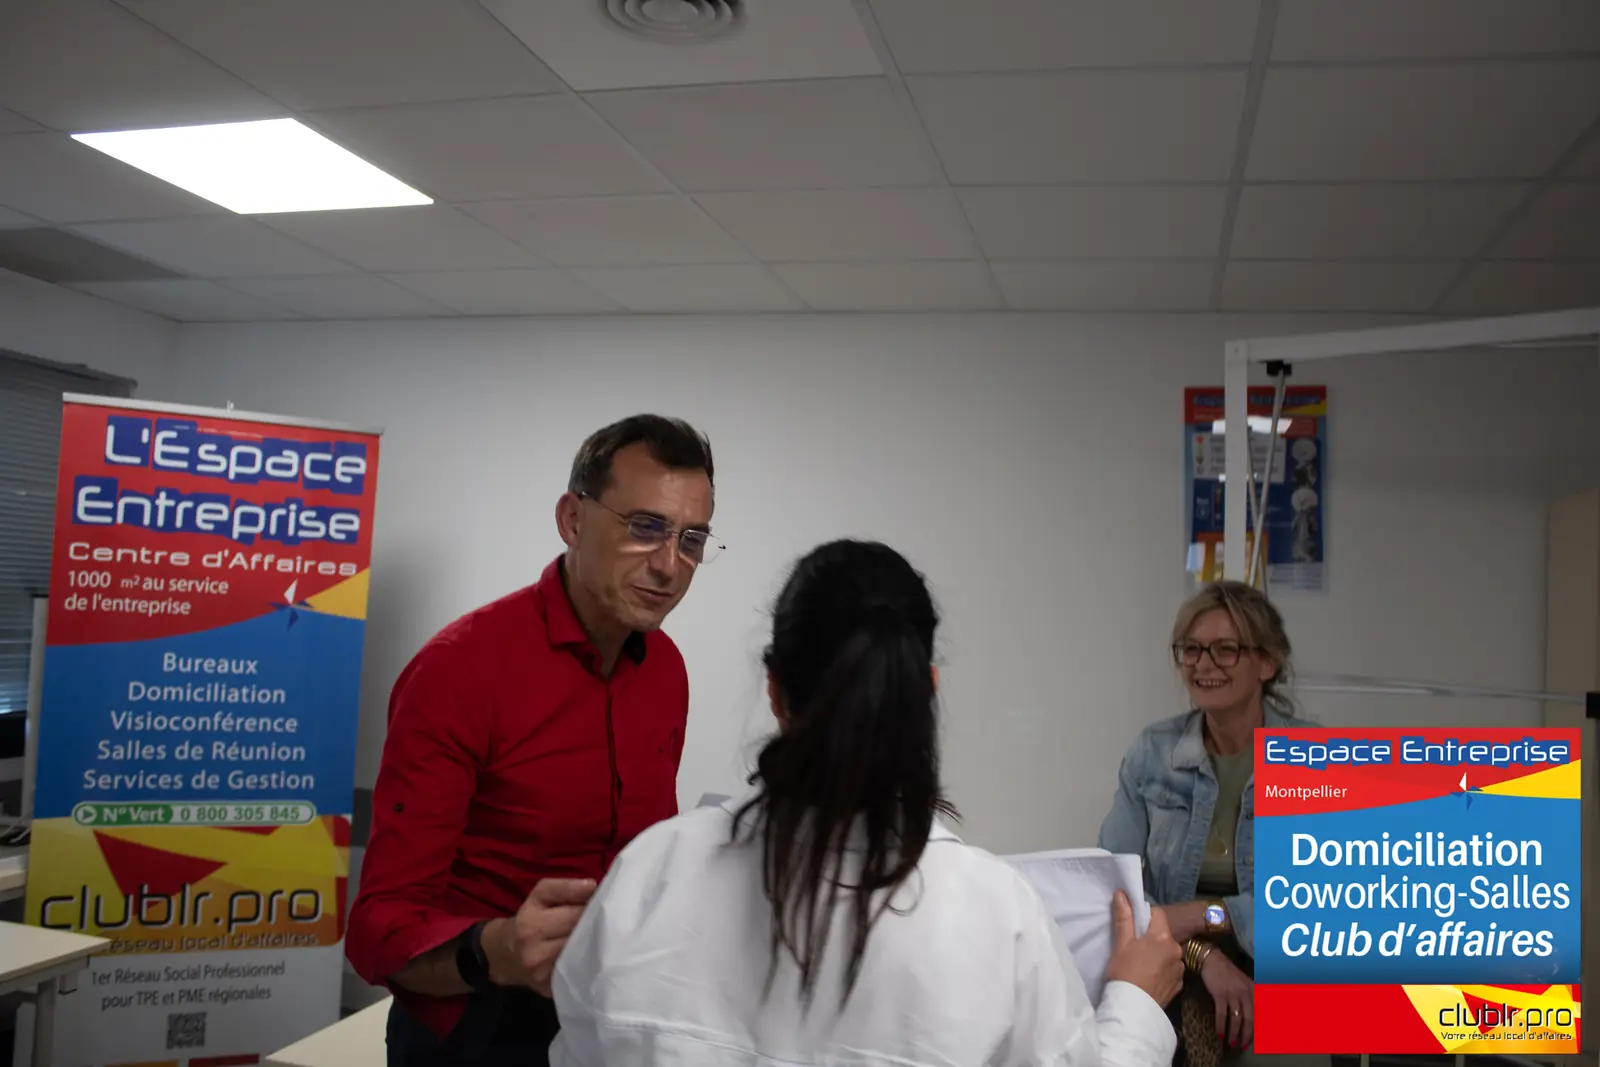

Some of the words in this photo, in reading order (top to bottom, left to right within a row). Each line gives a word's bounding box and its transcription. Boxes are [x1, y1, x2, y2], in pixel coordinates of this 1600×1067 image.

[105, 424, 366, 483] L'Espace
[76, 486, 360, 540] Entreprise
[68, 542, 191, 567] Centre
[201, 550, 357, 576] d'Affaires
[67, 570, 112, 588] 1000
[143, 579, 165, 591] au
[168, 577, 229, 594] service
[64, 595, 88, 610] de
[92, 596, 191, 617] l'entreprise
[163, 652, 258, 675] Bureaux
[128, 681, 286, 704] Domiciliation
[110, 710, 298, 733] Visioconférence
[97, 740, 167, 761] Salles
[174, 742, 204, 760] de
[212, 741, 306, 761] Réunion
[83, 769, 183, 790] Services
[191, 771, 220, 790] de
[227, 771, 315, 791] Gestion
[129, 806, 166, 822] Vert
[180, 806, 191, 821] 0
[196, 806, 228, 821] 800
[233, 806, 264, 821] 305
[270, 806, 301, 821] 845
[40, 882, 323, 933] clublr.pro
[108, 936, 174, 952] éseau
[180, 934, 227, 950] local
[91, 970, 111, 987] 1er
[116, 966, 161, 984] Réseau
[164, 965, 201, 982] Social
[203, 961, 286, 980] Professionnel
[101, 993, 133, 1011] pour
[137, 991, 160, 1006] TPE
[163, 991, 175, 1004] et
[178, 989, 205, 1003] PME
[208, 985, 272, 1005] régionales
